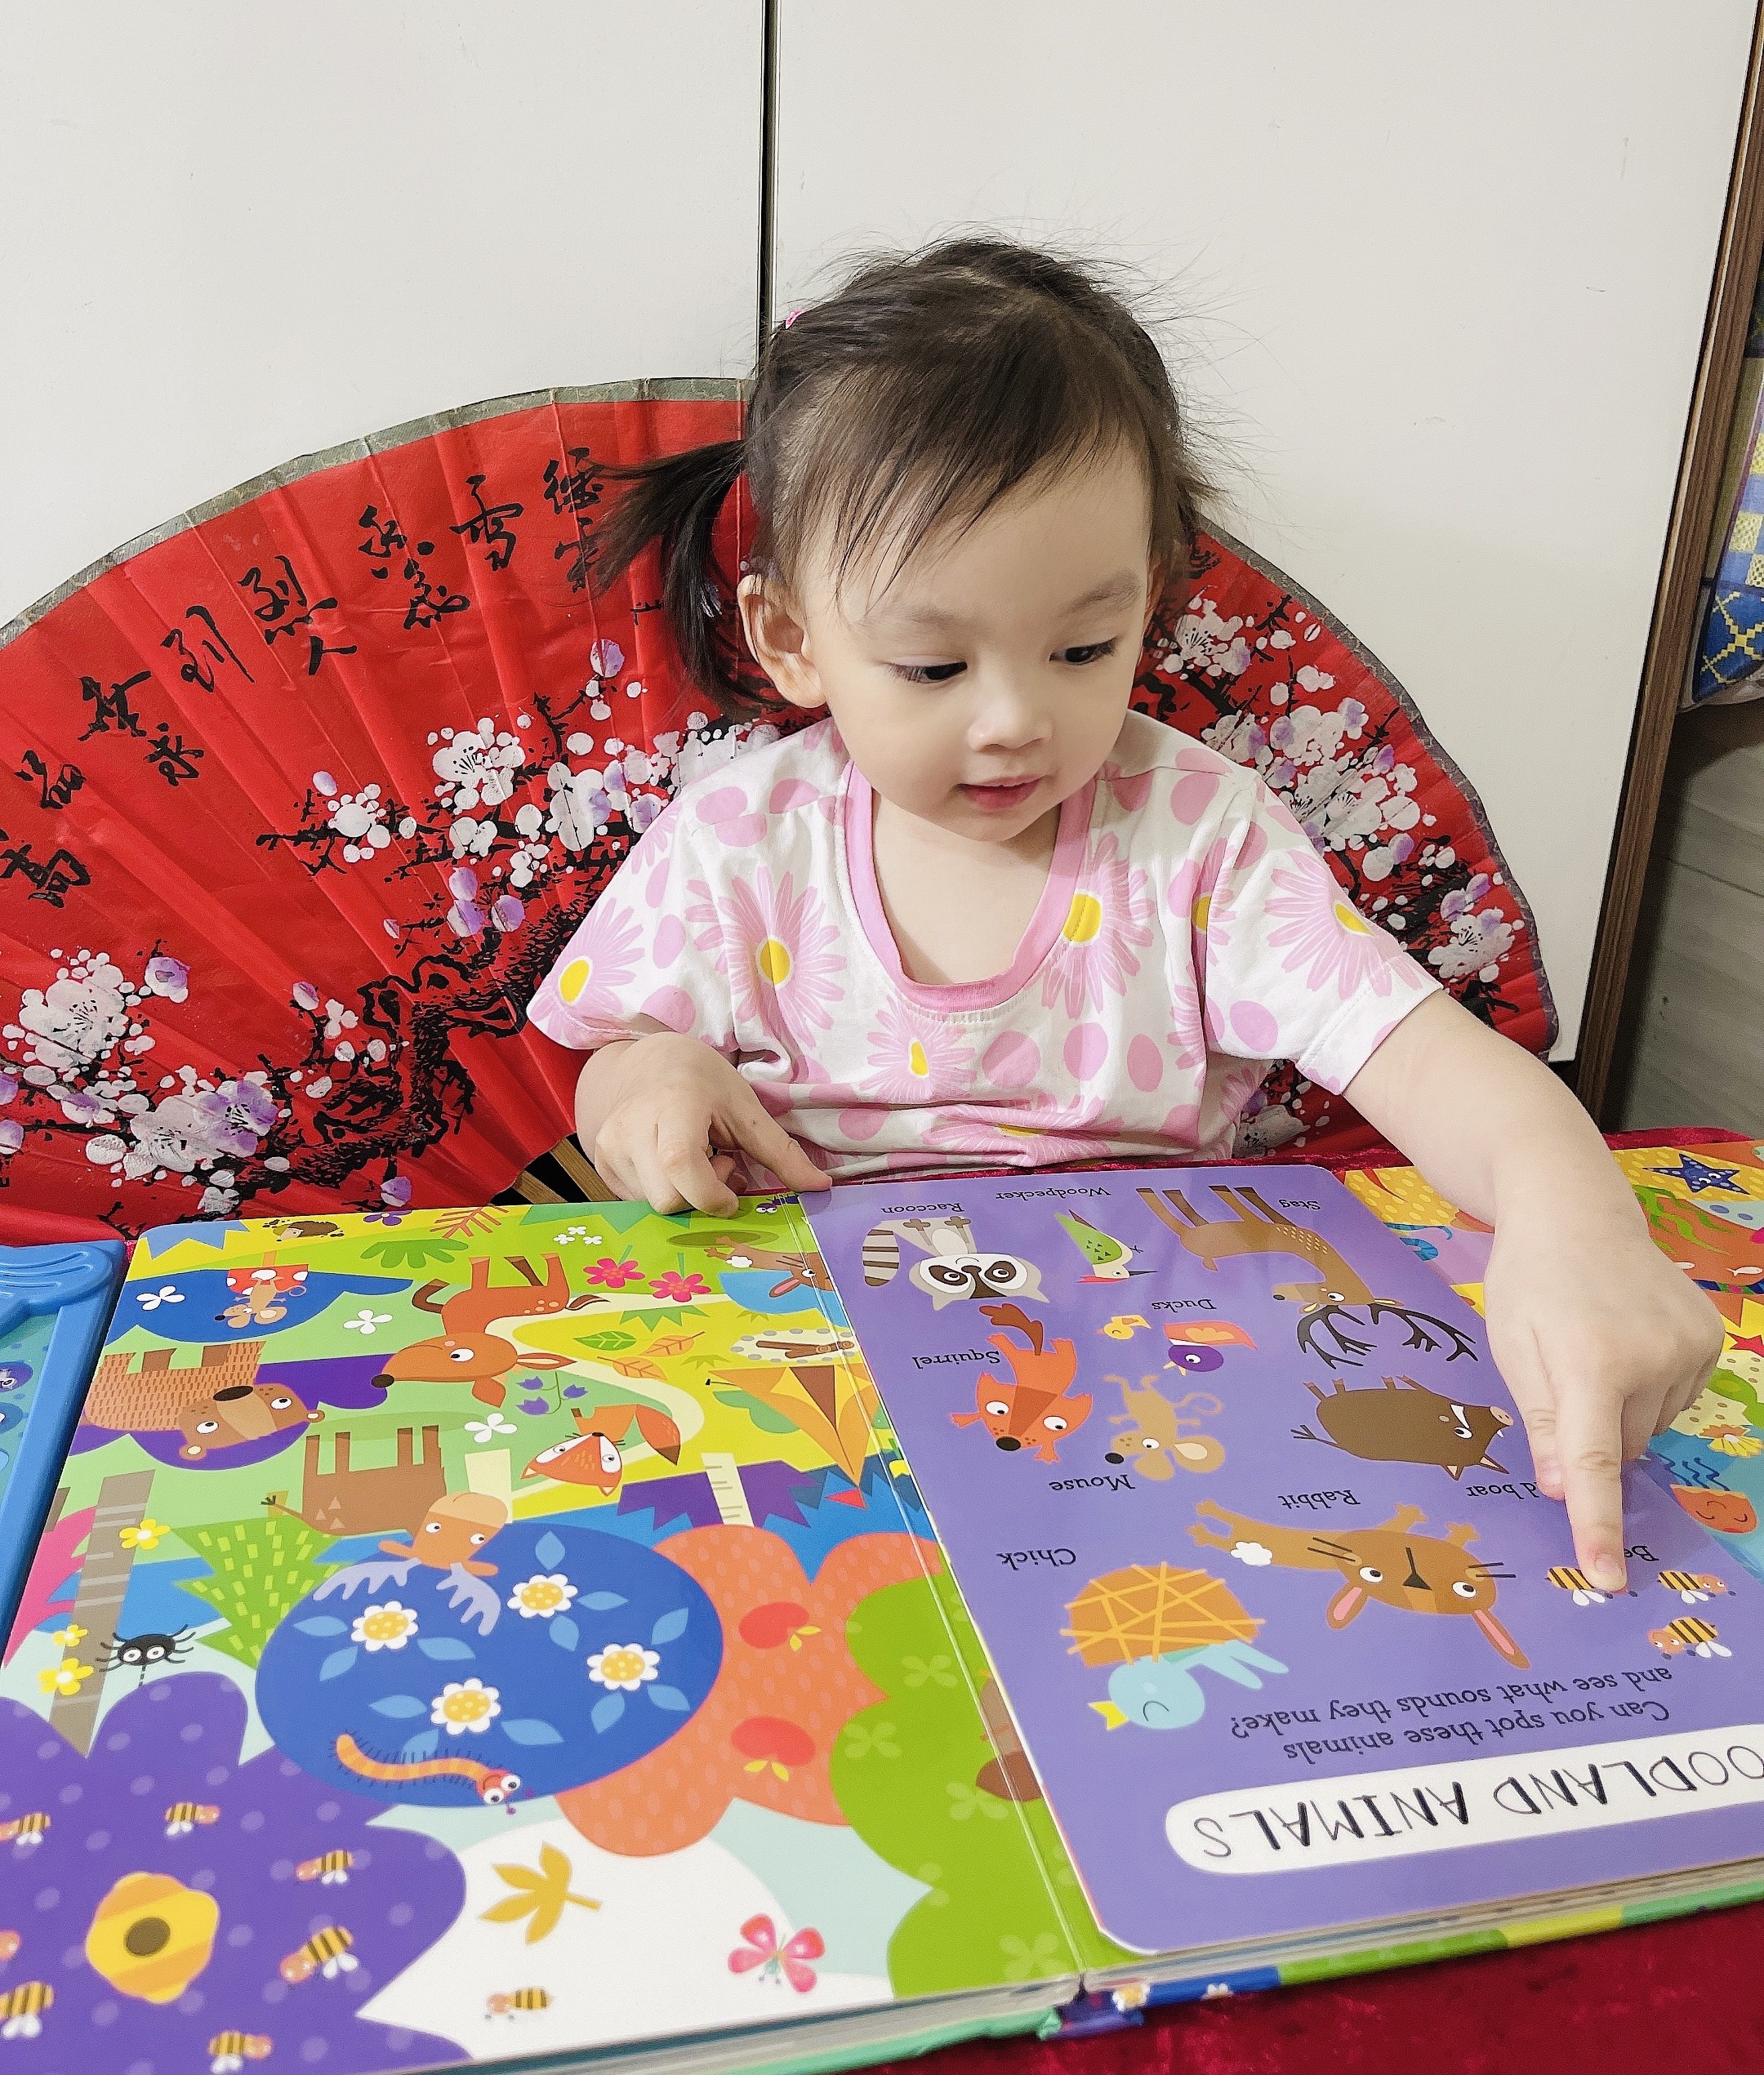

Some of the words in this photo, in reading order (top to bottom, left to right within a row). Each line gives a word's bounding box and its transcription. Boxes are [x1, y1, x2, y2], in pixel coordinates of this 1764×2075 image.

[995, 1186, 1111, 1201] Woodpecker
[1277, 1198, 1321, 1212] Stag
[880, 1201, 965, 1214] Raccoon
[1151, 1298, 1218, 1313] Ducks
[911, 1348, 1000, 1371] Squirrel
[1048, 1473, 1136, 1493] Mouse
[1465, 1481, 1524, 1500] boar
[1280, 1489, 1361, 1510] Rabbit
[996, 1547, 1076, 1570] Chick
[1624, 1544, 1660, 1562] Be
[1572, 1674, 1615, 1690] see
[1621, 1667, 1673, 1692] and
[1396, 1688, 1491, 1718] sounds
[1496, 1679, 1568, 1704] what
[1330, 1699, 1392, 1724] they
[1549, 1701, 1605, 1726] you
[1610, 1701, 1669, 1721] Can
[1231, 1708, 1321, 1739] make?
[1403, 1721, 1484, 1746] these
[1485, 1709, 1545, 1738] spot
[1283, 1730, 1394, 1765] animals
[1493, 1745, 1764, 1815] OODLAND
[1193, 1780, 1469, 1858] ANIMALS
